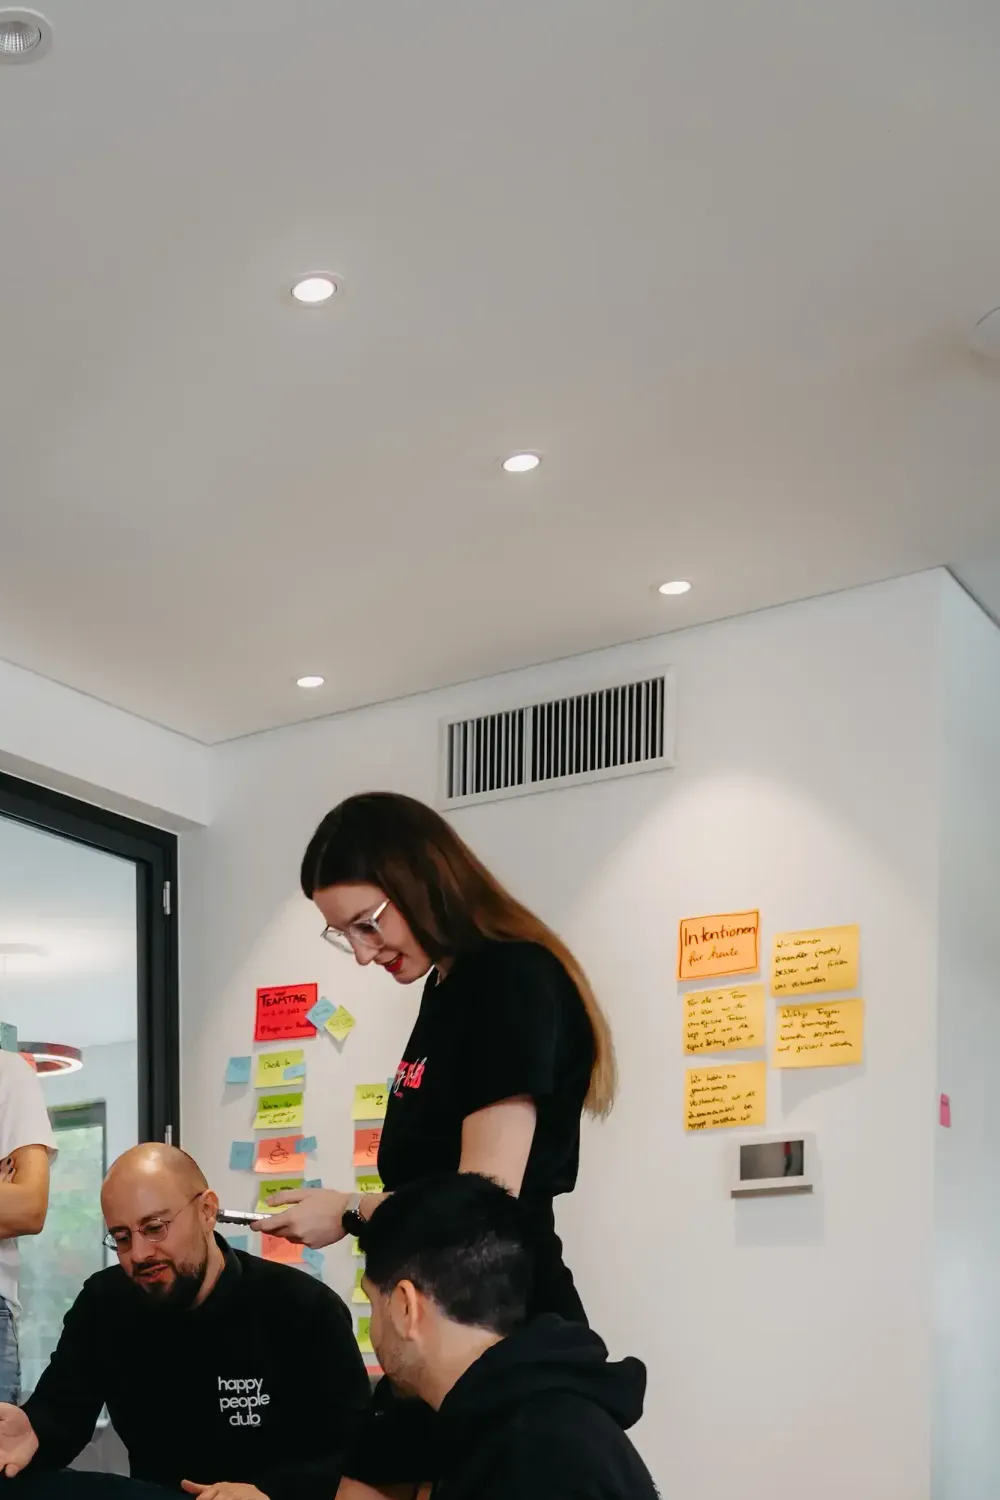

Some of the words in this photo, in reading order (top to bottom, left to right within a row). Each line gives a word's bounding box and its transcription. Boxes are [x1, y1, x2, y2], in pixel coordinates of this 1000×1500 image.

[684, 924, 757, 947] Intentionen
[218, 1375, 264, 1398] happy
[219, 1394, 271, 1413] people
[229, 1411, 261, 1426] club
